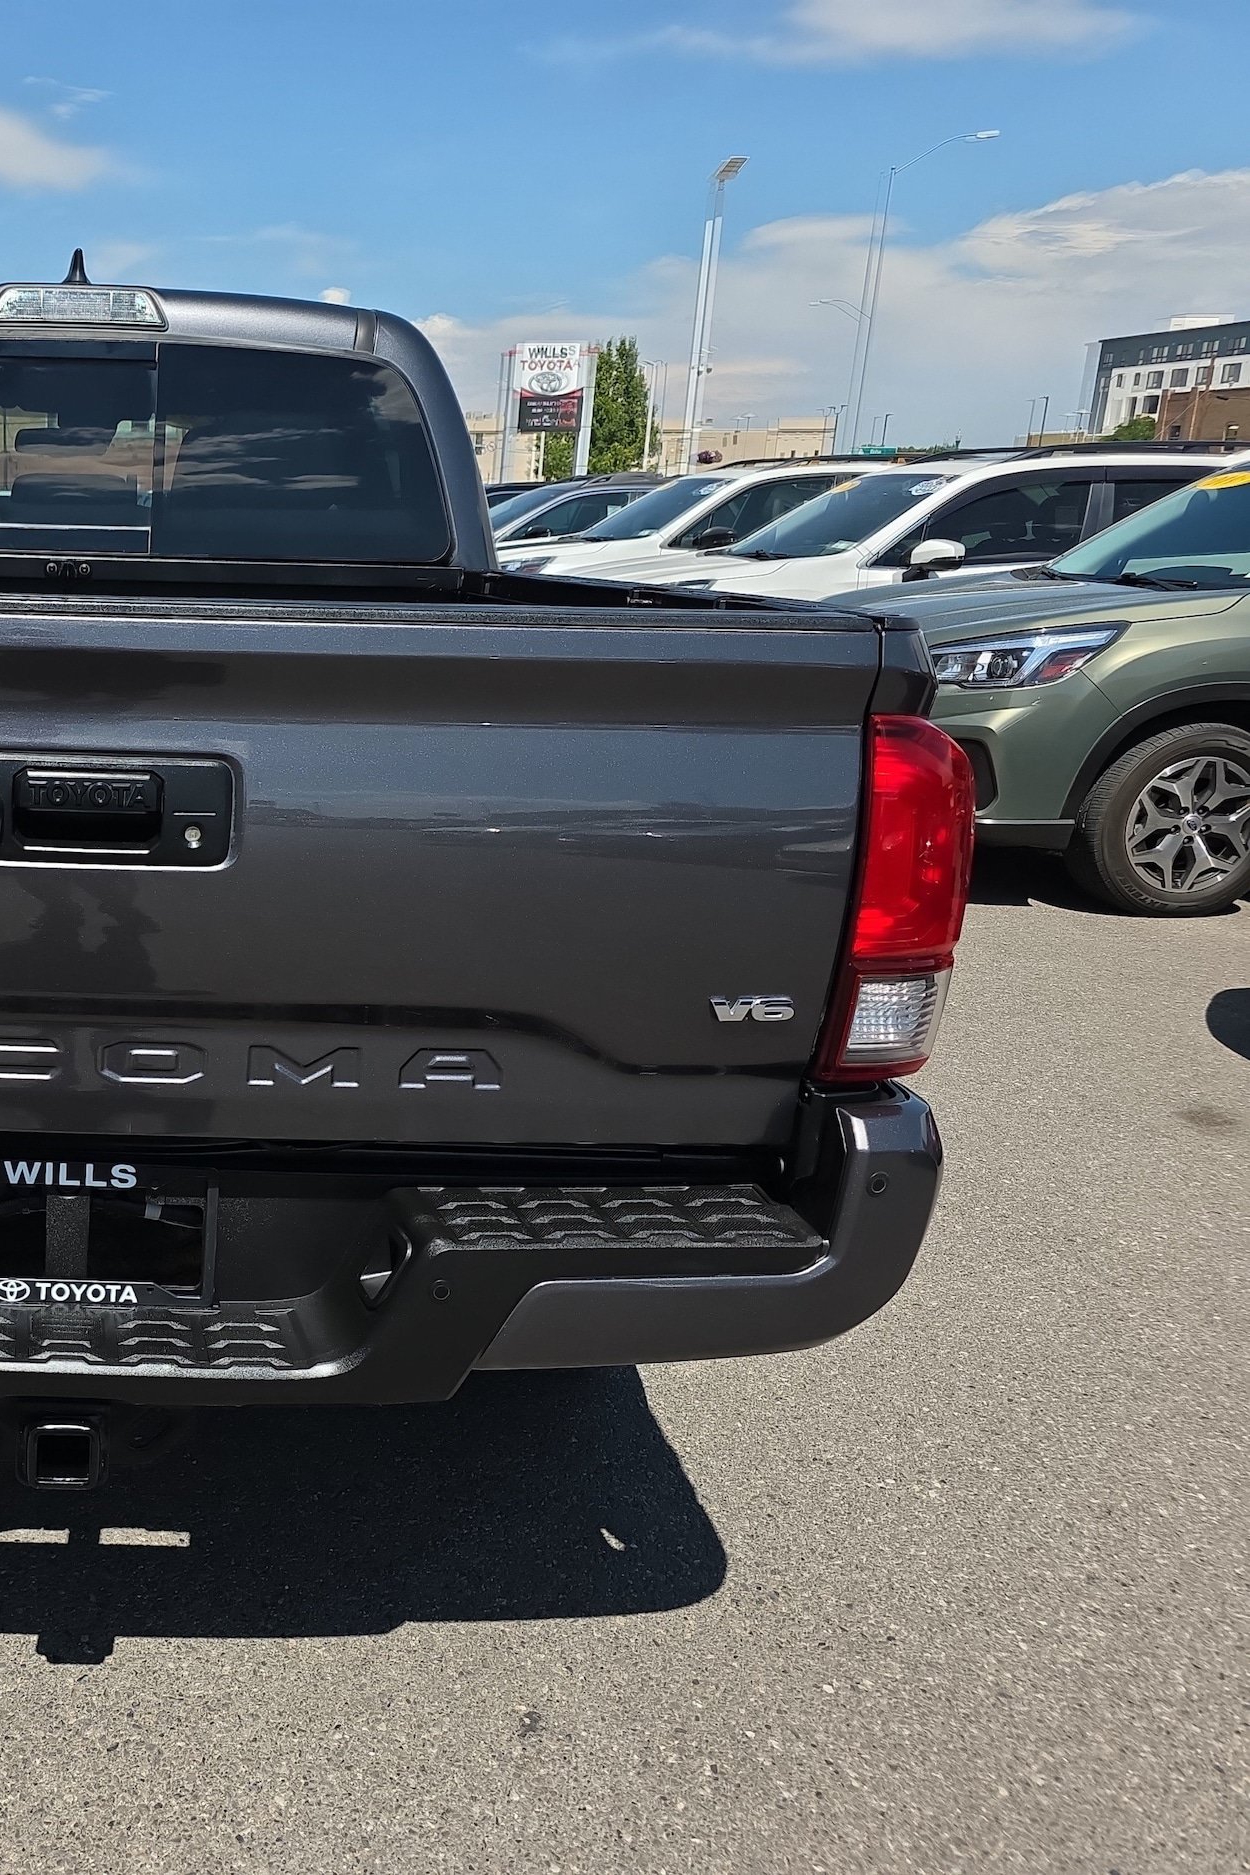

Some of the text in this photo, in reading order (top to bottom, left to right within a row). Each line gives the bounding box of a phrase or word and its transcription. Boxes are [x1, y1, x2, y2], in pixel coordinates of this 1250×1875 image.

[528, 346, 569, 359] WILLS
[520, 359, 574, 371] TOYOTA
[27, 779, 151, 809] TOYOTA
[709, 995, 795, 1022] V6
[3, 1160, 138, 1189] WILLS
[35, 1282, 138, 1304] TOYOTA
